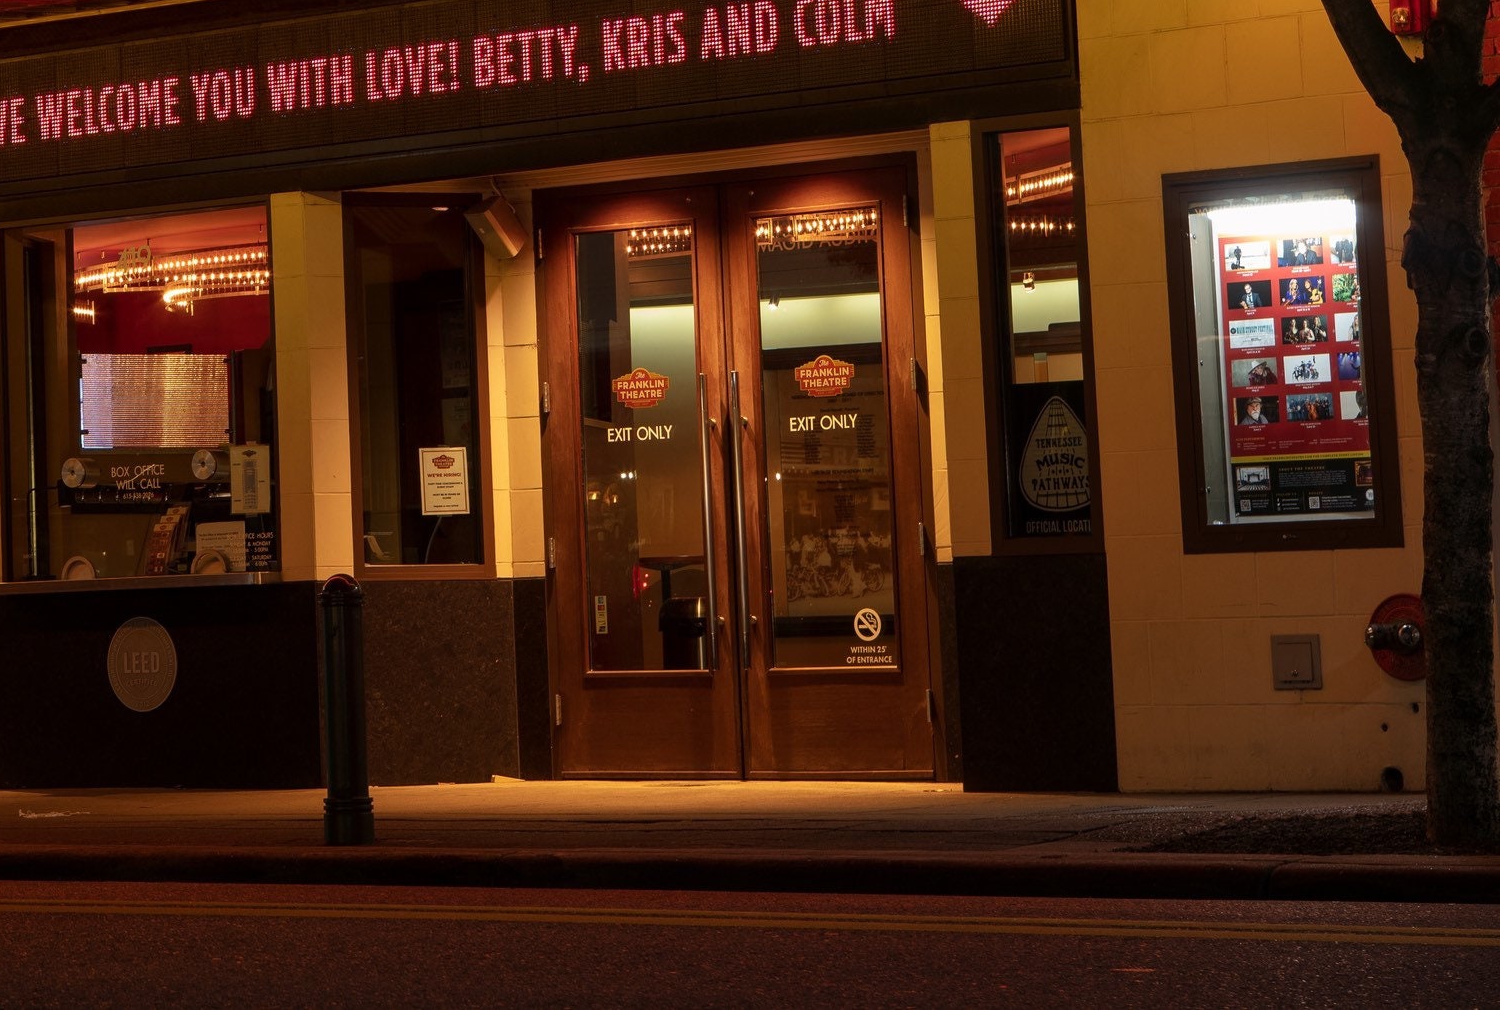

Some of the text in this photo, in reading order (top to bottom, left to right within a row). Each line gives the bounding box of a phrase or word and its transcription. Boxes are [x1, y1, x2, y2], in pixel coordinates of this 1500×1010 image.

[33, 77, 181, 141] WELCOME
[188, 67, 256, 122] YOU
[266, 54, 354, 113] WITH
[364, 37, 461, 101] LOVE!
[472, 24, 590, 88] BETTY,
[601, 11, 686, 72] KRIS
[700, 0, 779, 61] AND
[800, 367, 850, 379] FRANKLIN
[617, 379, 665, 390] FRANKLIN
[803, 377, 847, 388] THEATRE
[619, 389, 662, 400] THEATRE
[789, 413, 858, 432] EXIT ONLY
[607, 424, 673, 442] EXIT ONLY
[1034, 436, 1083, 449] TENNESSEE
[1035, 453, 1086, 471] MUSIC
[110, 464, 165, 478] BOX OFFICE
[115, 478, 161, 490] WILL CALL
[1026, 520, 1062, 534] OFFICIAL
[850, 646, 876, 654] WITHIN
[123, 651, 160, 674] LEED
[846, 655, 892, 664] OF ENTRANCE
